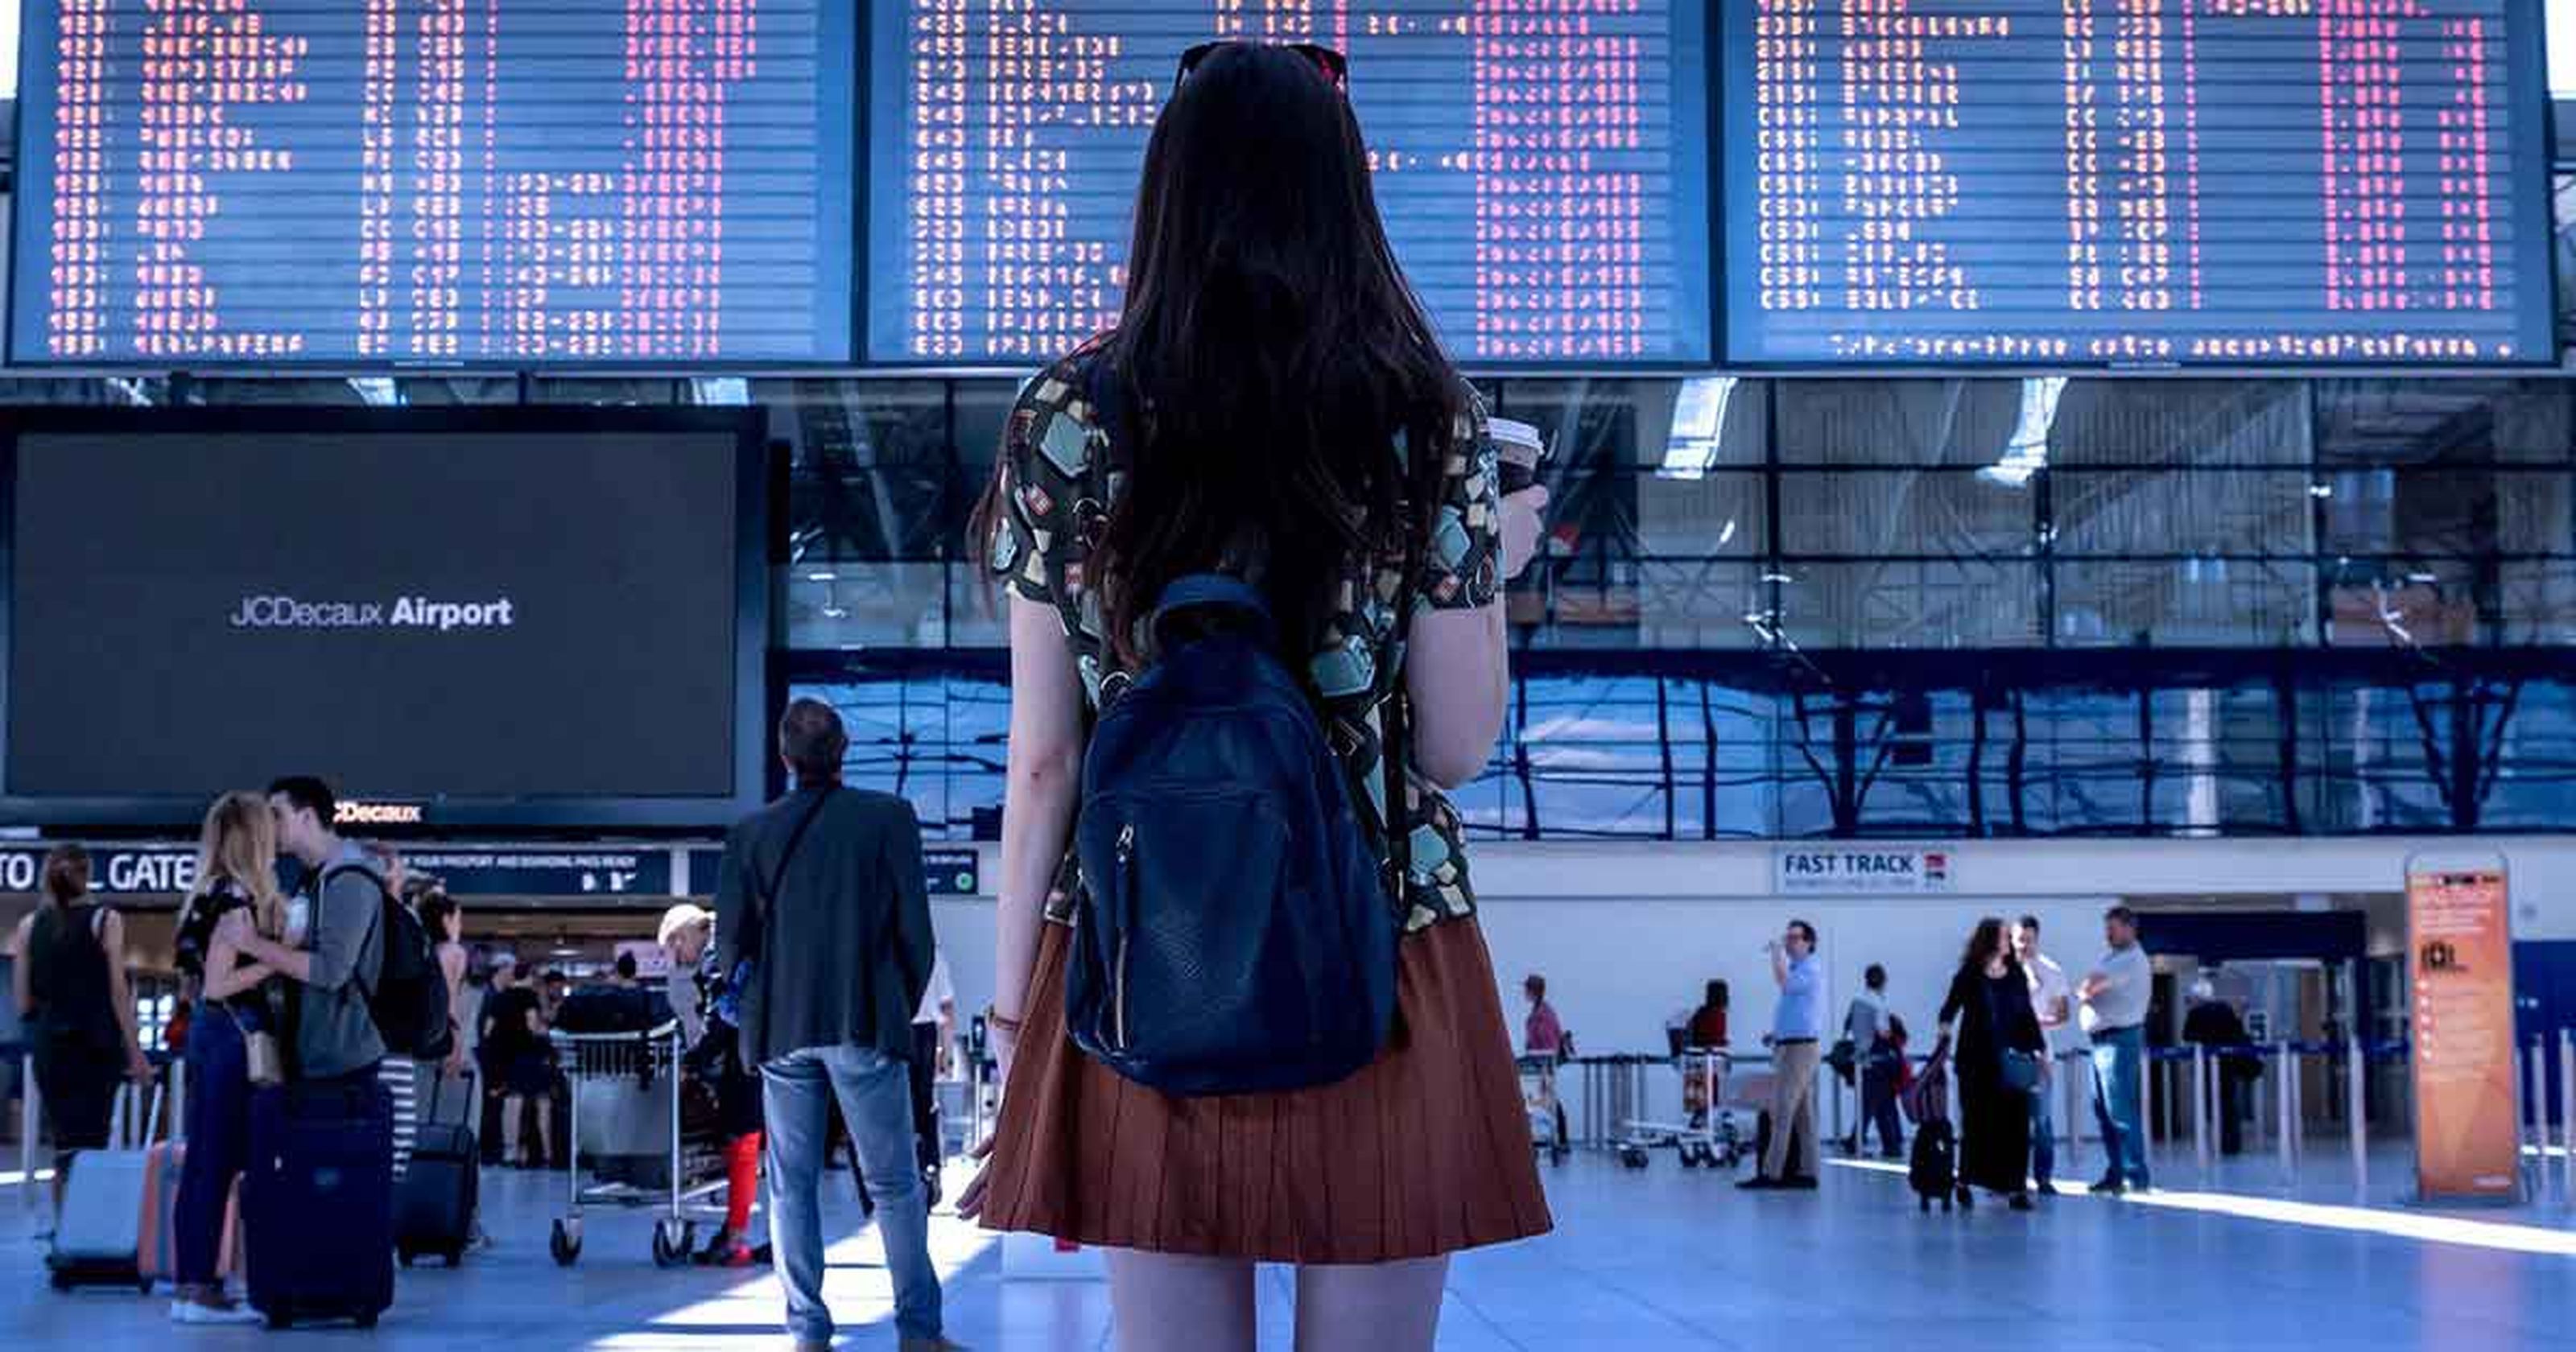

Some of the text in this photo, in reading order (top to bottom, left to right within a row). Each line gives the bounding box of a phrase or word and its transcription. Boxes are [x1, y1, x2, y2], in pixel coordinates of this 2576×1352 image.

[230, 596, 512, 630] JCDecaux Airport
[1785, 854, 1913, 874] FAST TRACK
